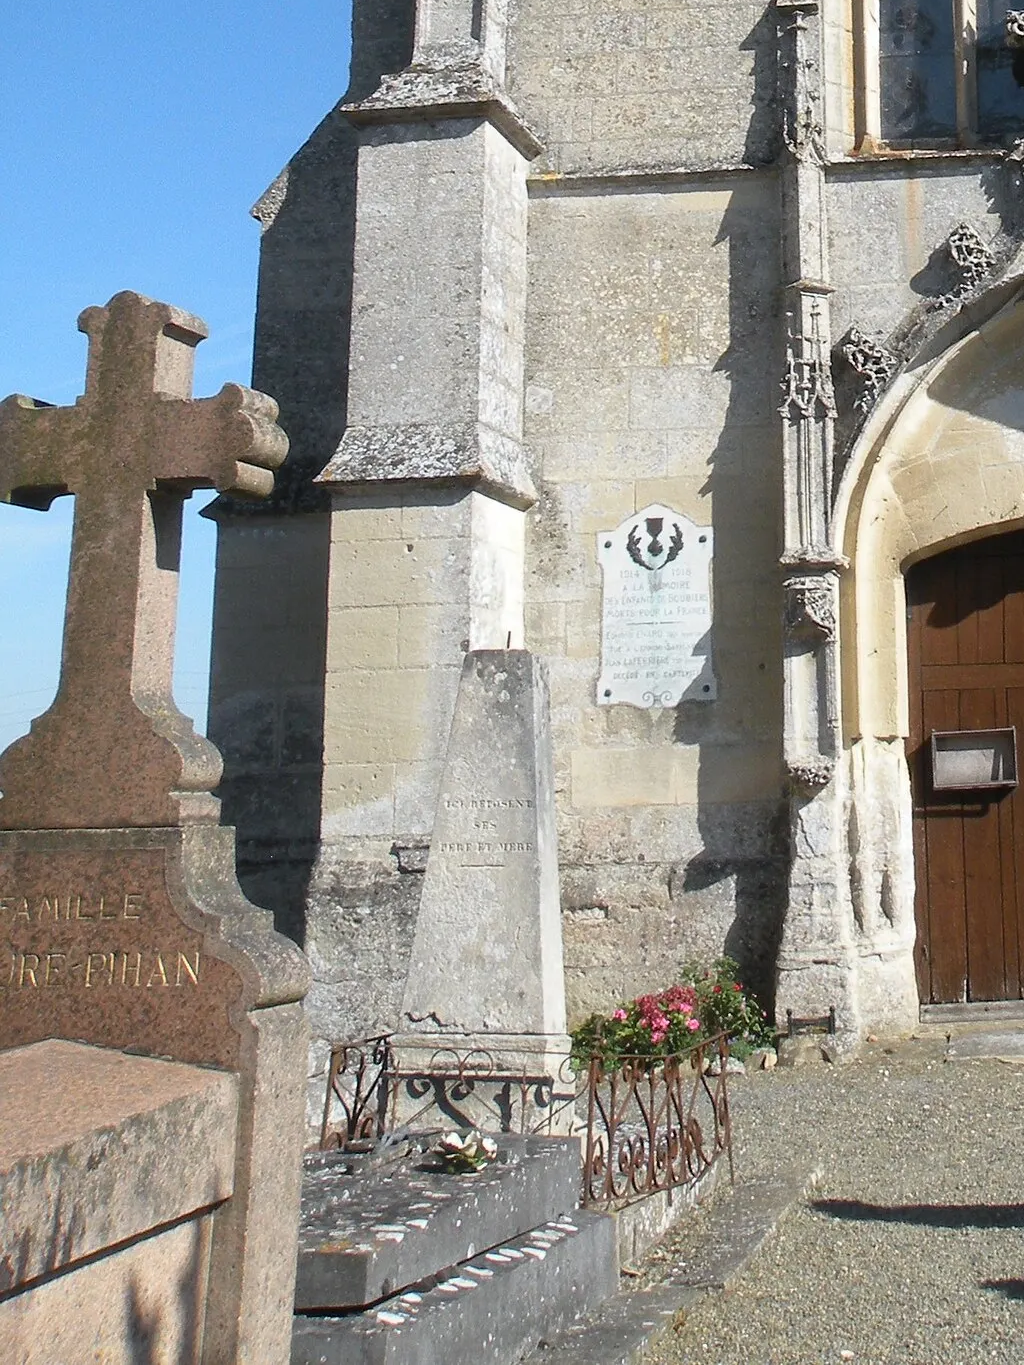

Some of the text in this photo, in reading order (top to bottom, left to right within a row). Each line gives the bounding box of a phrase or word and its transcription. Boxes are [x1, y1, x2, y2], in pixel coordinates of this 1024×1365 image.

[445, 799, 534, 809] ICI REPOSENT
[473, 820, 497, 830] SES
[440, 842, 533, 852] PERE ET MERE
